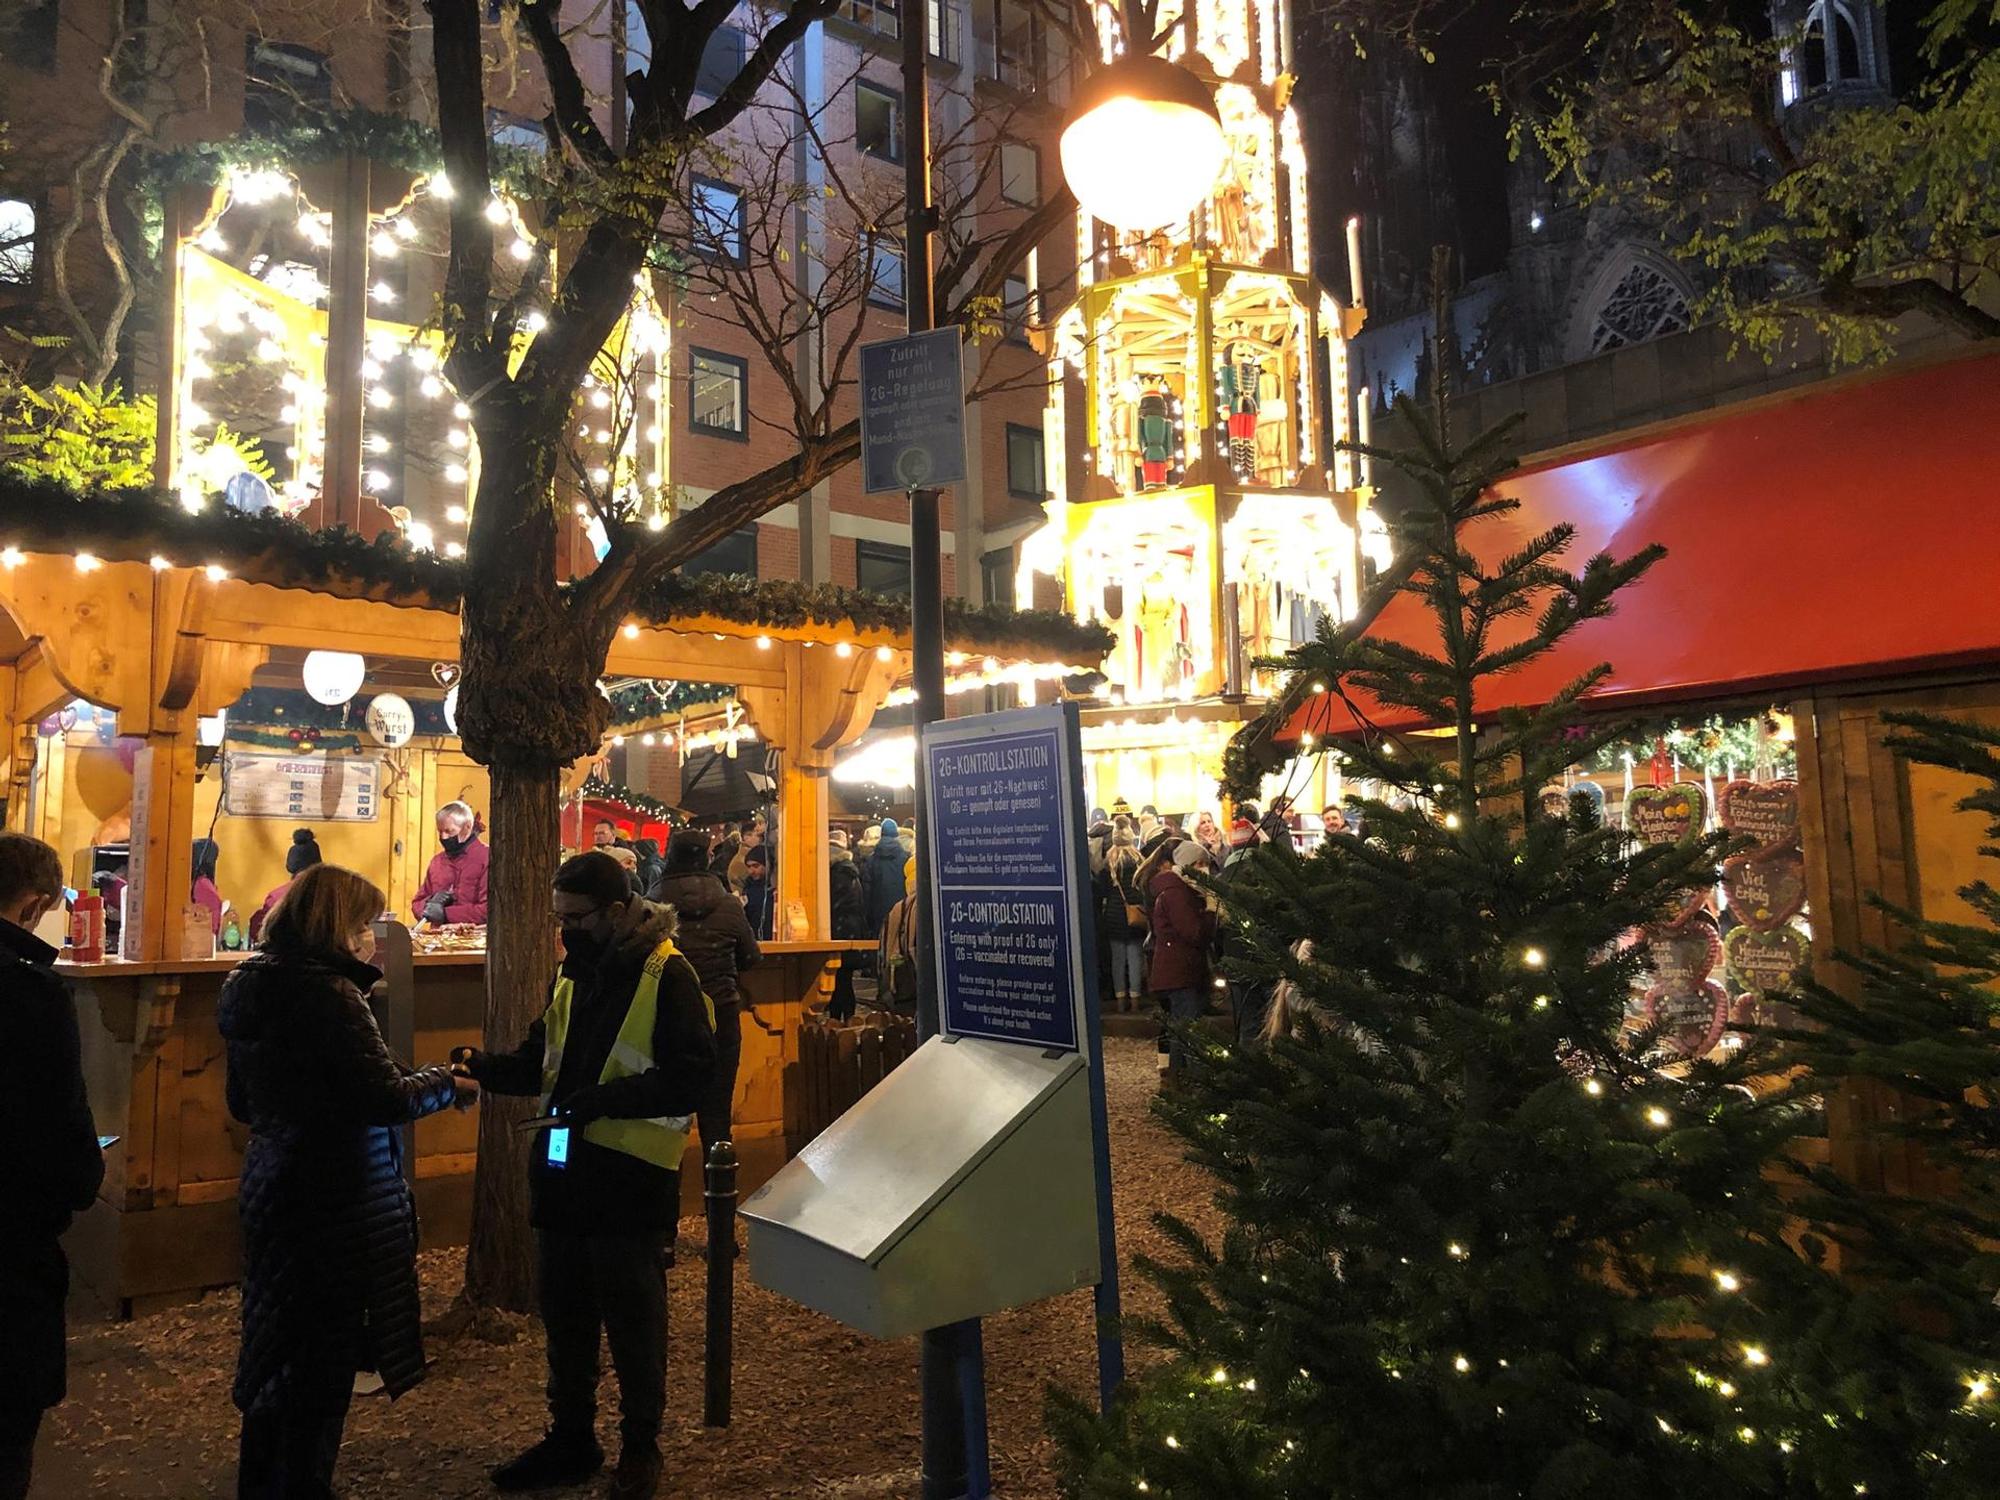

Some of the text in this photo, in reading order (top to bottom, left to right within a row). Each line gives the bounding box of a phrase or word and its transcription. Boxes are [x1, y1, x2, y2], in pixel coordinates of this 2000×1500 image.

[890, 344, 928, 362] Zutritt
[888, 360, 933, 380] nur mit
[870, 376, 951, 400] 2G-Regelung
[376, 708, 406, 721] Curry-
[375, 719, 406, 734] Wurst
[939, 745, 1048, 777] 2G-KONTROLLSTATION
[943, 776, 1048, 799] Zutritt nur mit 2G-Nachweis!
[994, 797, 1008, 811] oder
[1741, 869, 1767, 887] Viel
[1735, 884, 1770, 906] Erfolg
[950, 902, 1055, 926] 2G-CONTROLSTATION
[950, 930, 1058, 953] Entering with proof of 2G only!
[974, 950, 1008, 964] vaccinated
[1009, 953, 1016, 964] or
